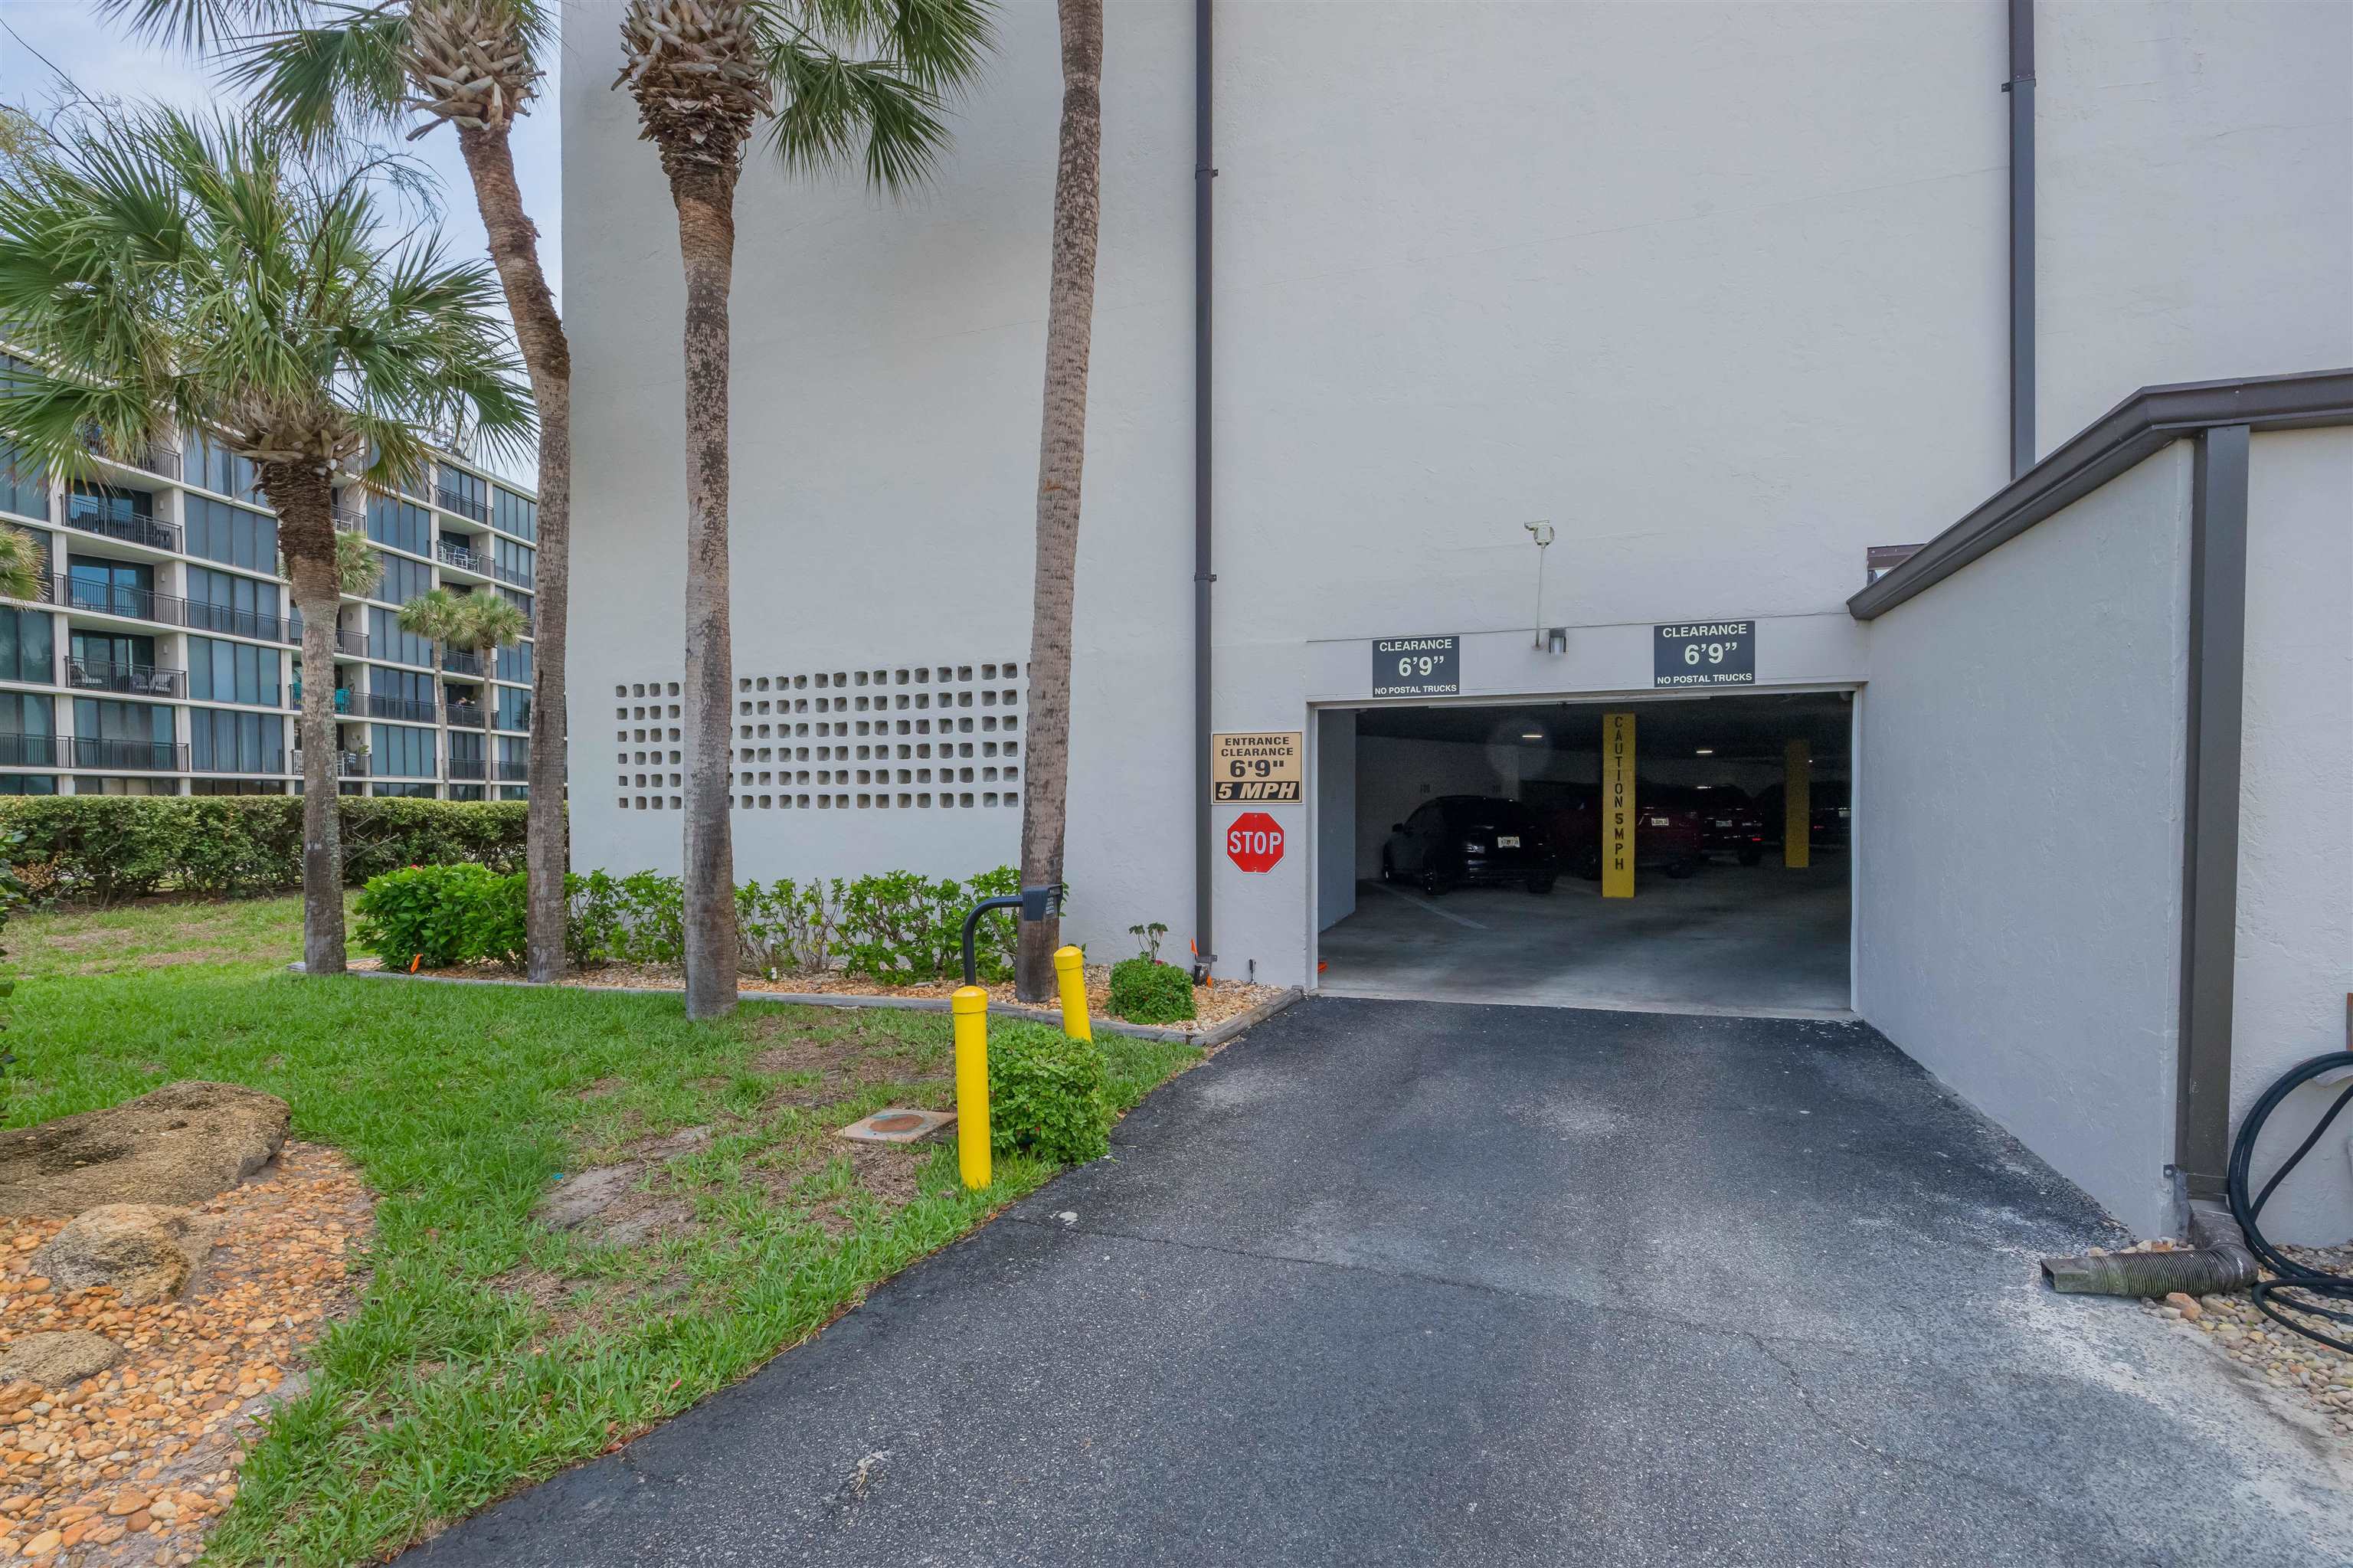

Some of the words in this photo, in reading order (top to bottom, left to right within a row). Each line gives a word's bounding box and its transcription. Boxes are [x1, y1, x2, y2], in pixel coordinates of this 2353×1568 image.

[1663, 624, 1747, 637] CLEARANCE
[1379, 639, 1452, 651] CLEARANCE
[1674, 675, 1710, 683] POSTAL
[1713, 673, 1752, 682] TRUCKS
[1226, 737, 1290, 745] ENTRANCE
[1221, 748, 1294, 757] CLEARANCE
[1615, 716, 1623, 808] CAUTION
[1218, 783, 1234, 799] 5
[1239, 782, 1297, 799] MPH
[1229, 831, 1282, 855] STOP
